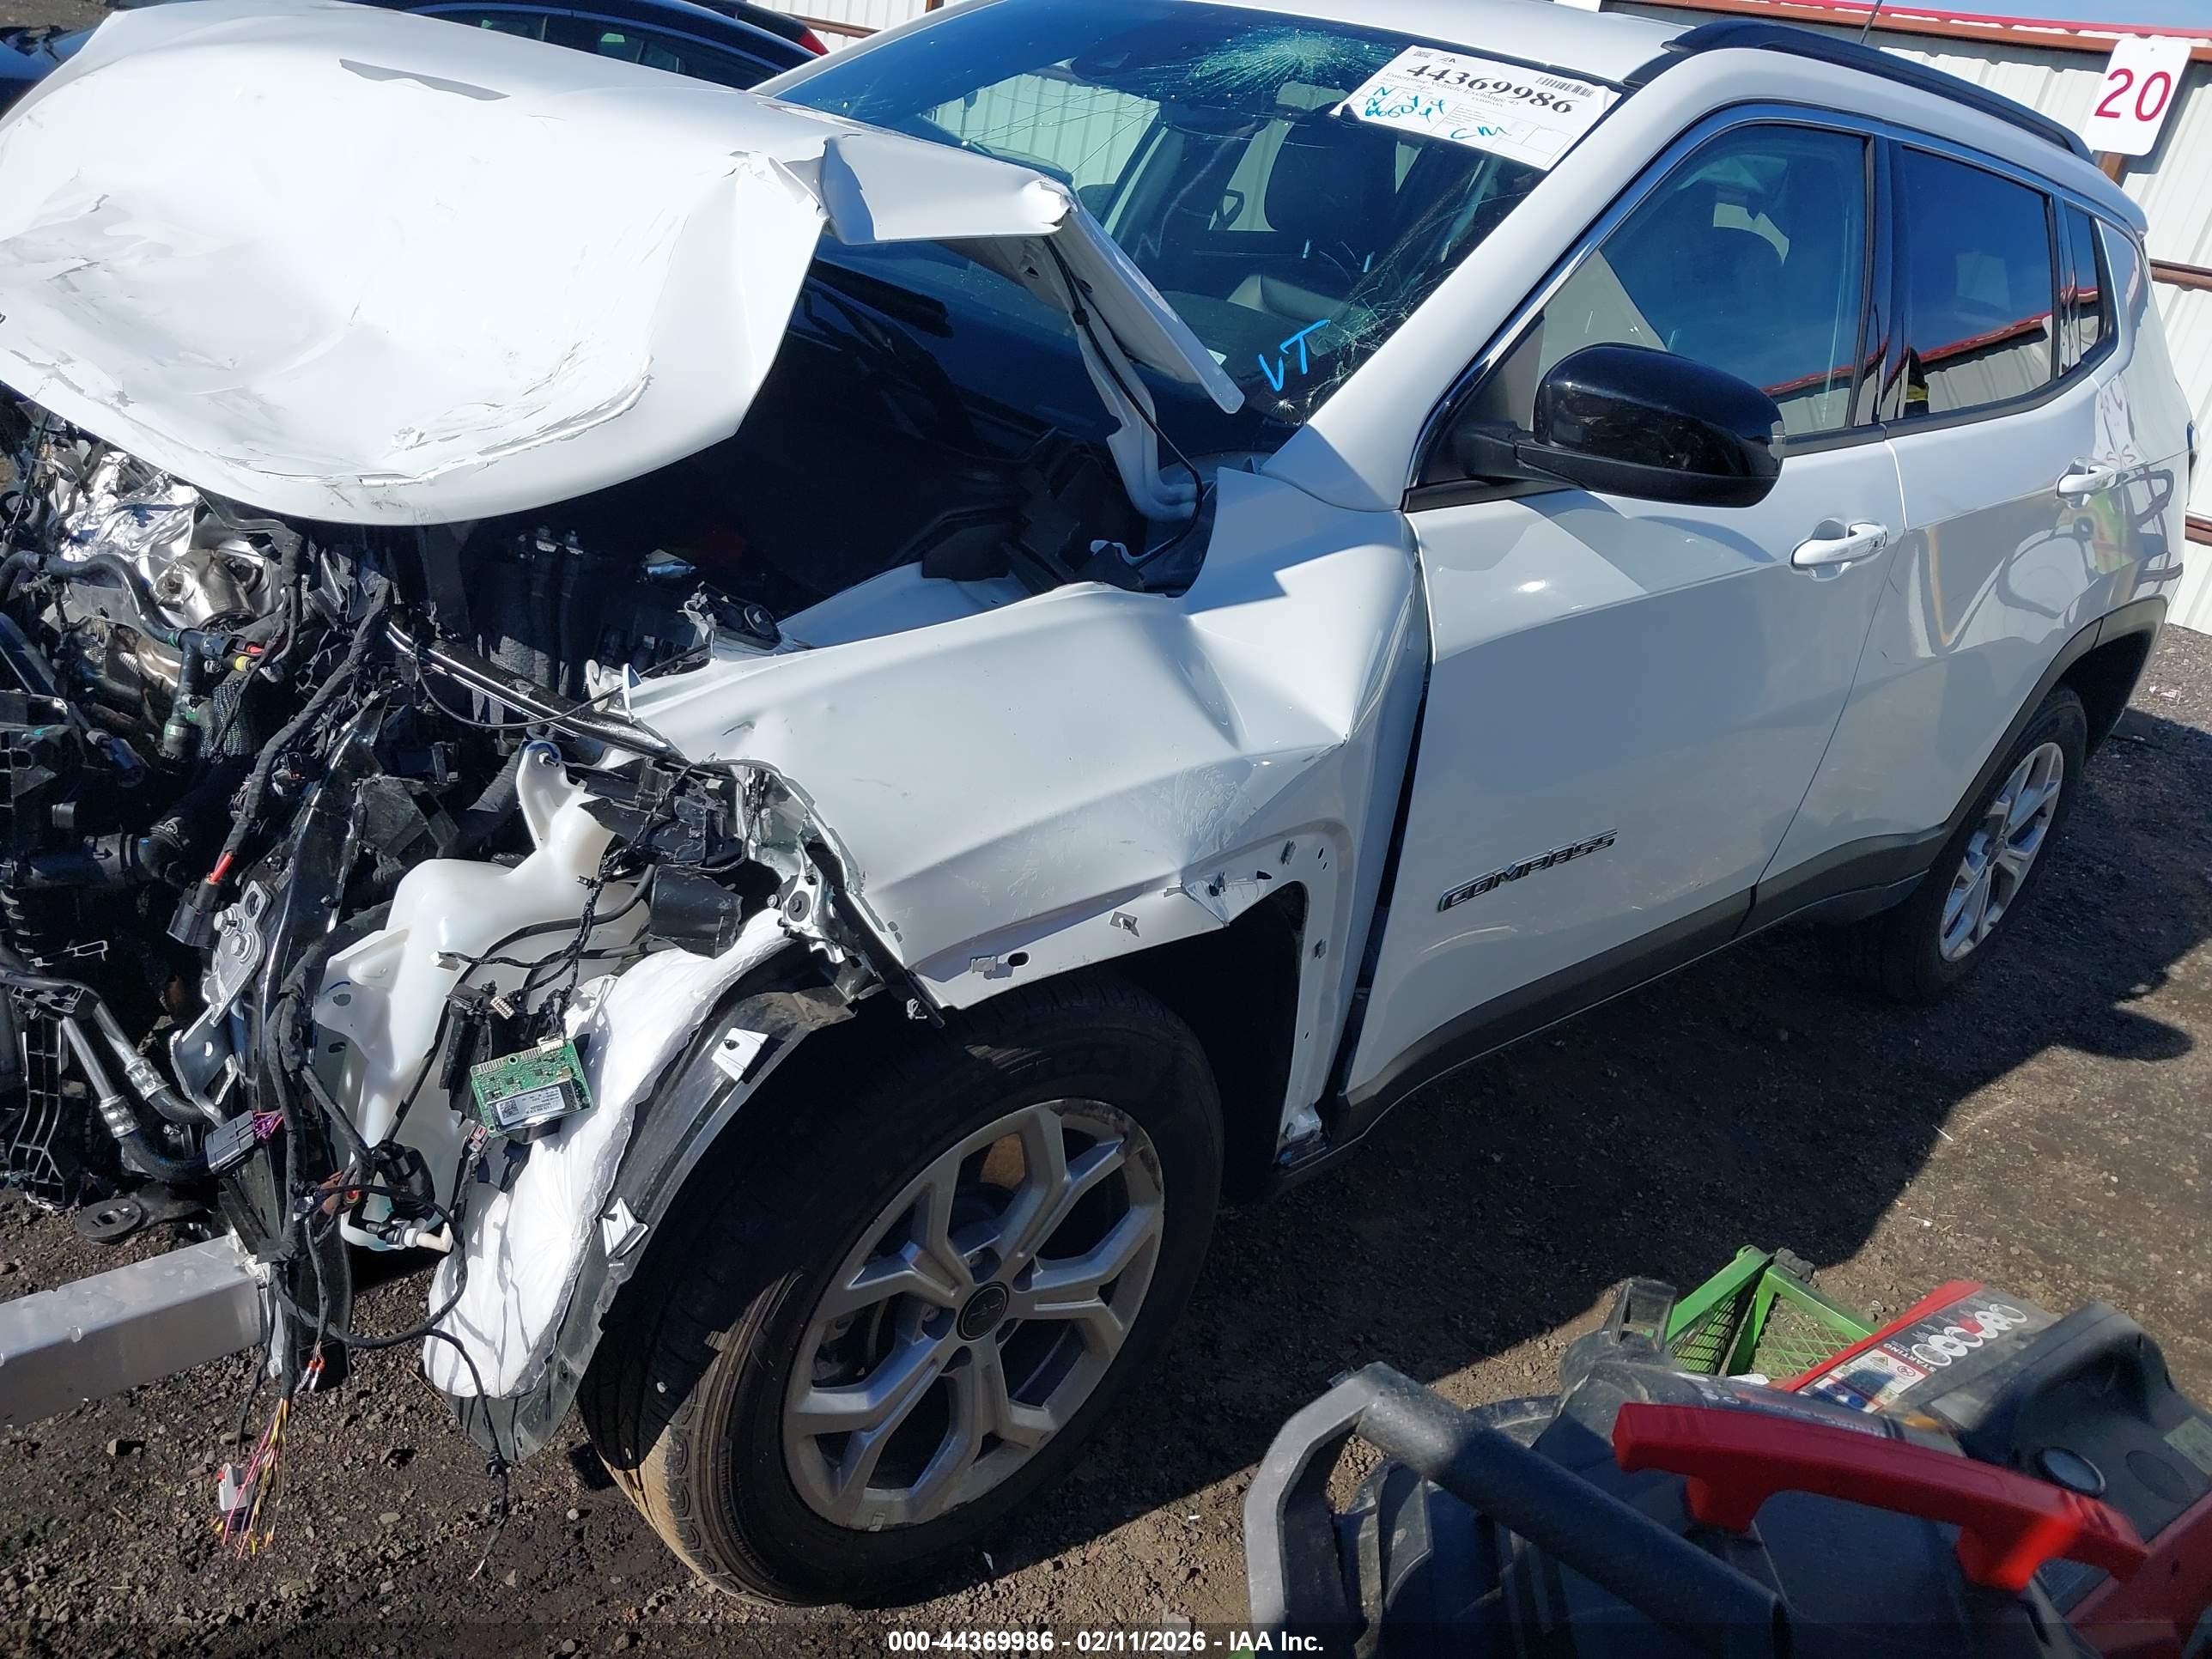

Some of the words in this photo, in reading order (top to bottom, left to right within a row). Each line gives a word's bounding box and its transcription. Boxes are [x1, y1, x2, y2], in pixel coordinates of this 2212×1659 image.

[1406, 64, 1575, 113] 44369986
[2094, 68, 2172, 122] 20
[1437, 828, 1618, 912] COMPASS
